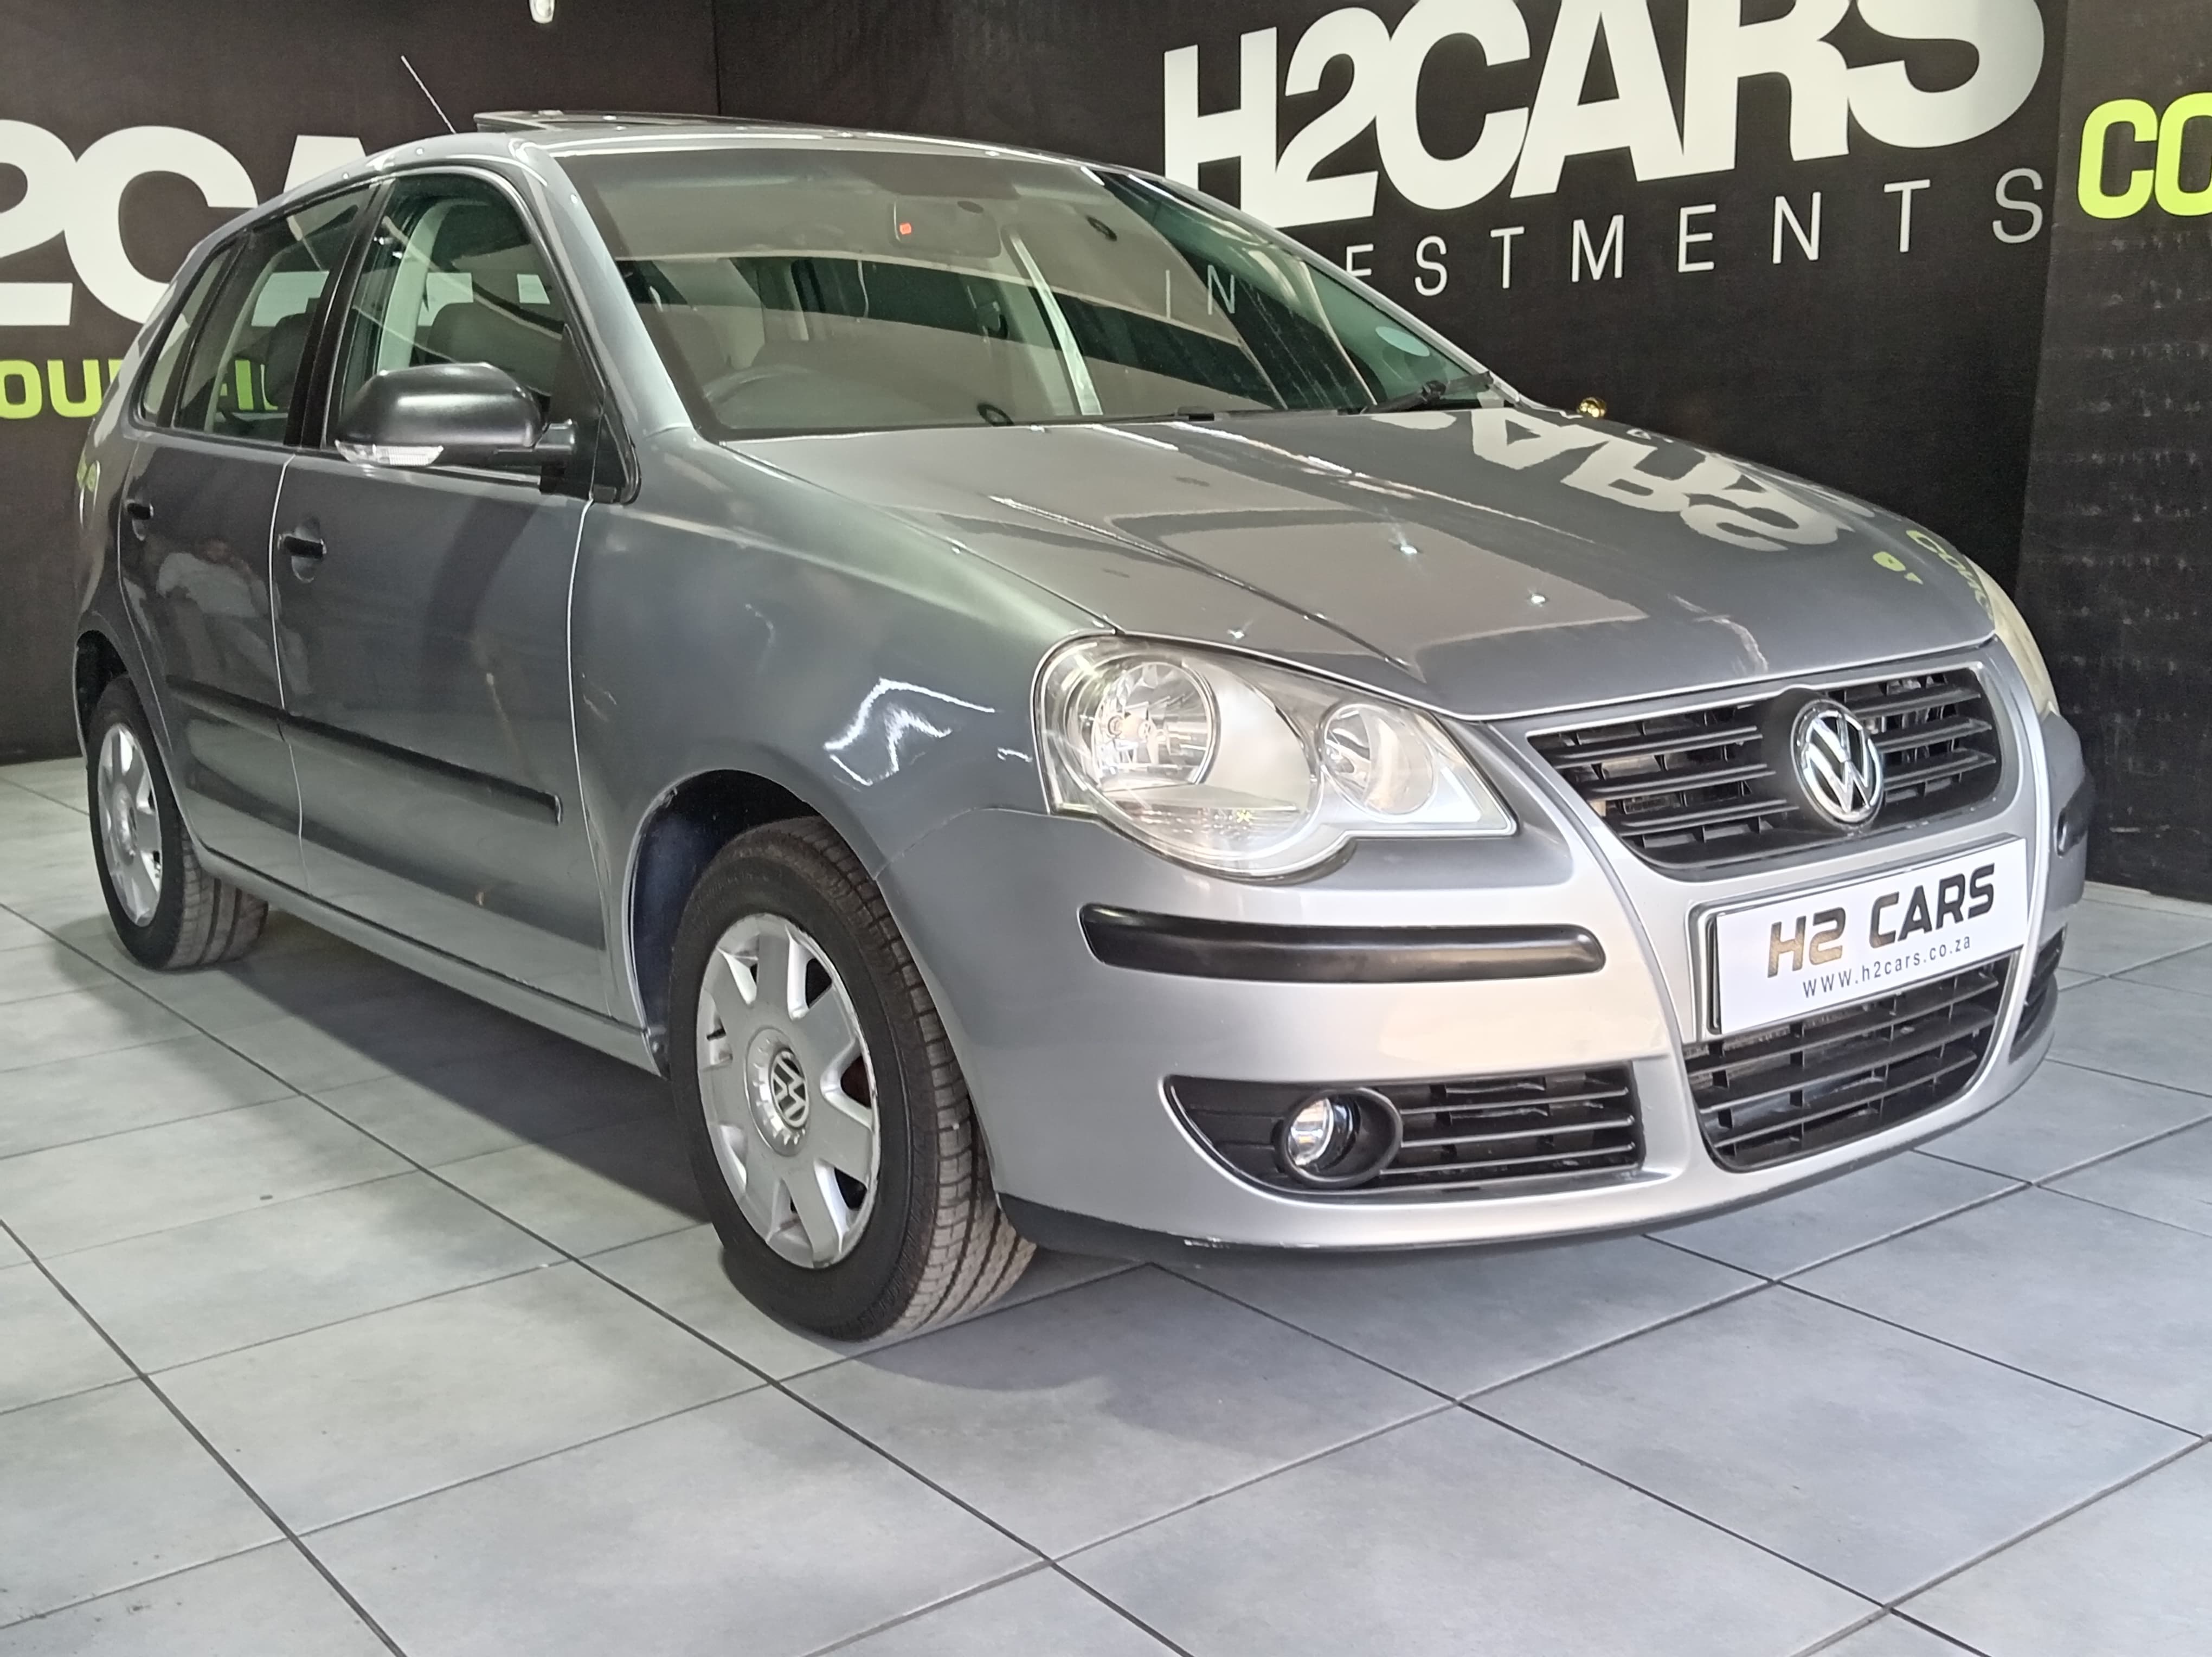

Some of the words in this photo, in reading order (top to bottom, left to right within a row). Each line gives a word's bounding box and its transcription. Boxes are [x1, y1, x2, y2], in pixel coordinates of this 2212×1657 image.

[1164, 0, 2046, 230] H2CARS
[1767, 907, 1846, 978] H2
[1869, 863, 1995, 949] CARS
[1802, 934, 1972, 999] www.h2cars.co.za
